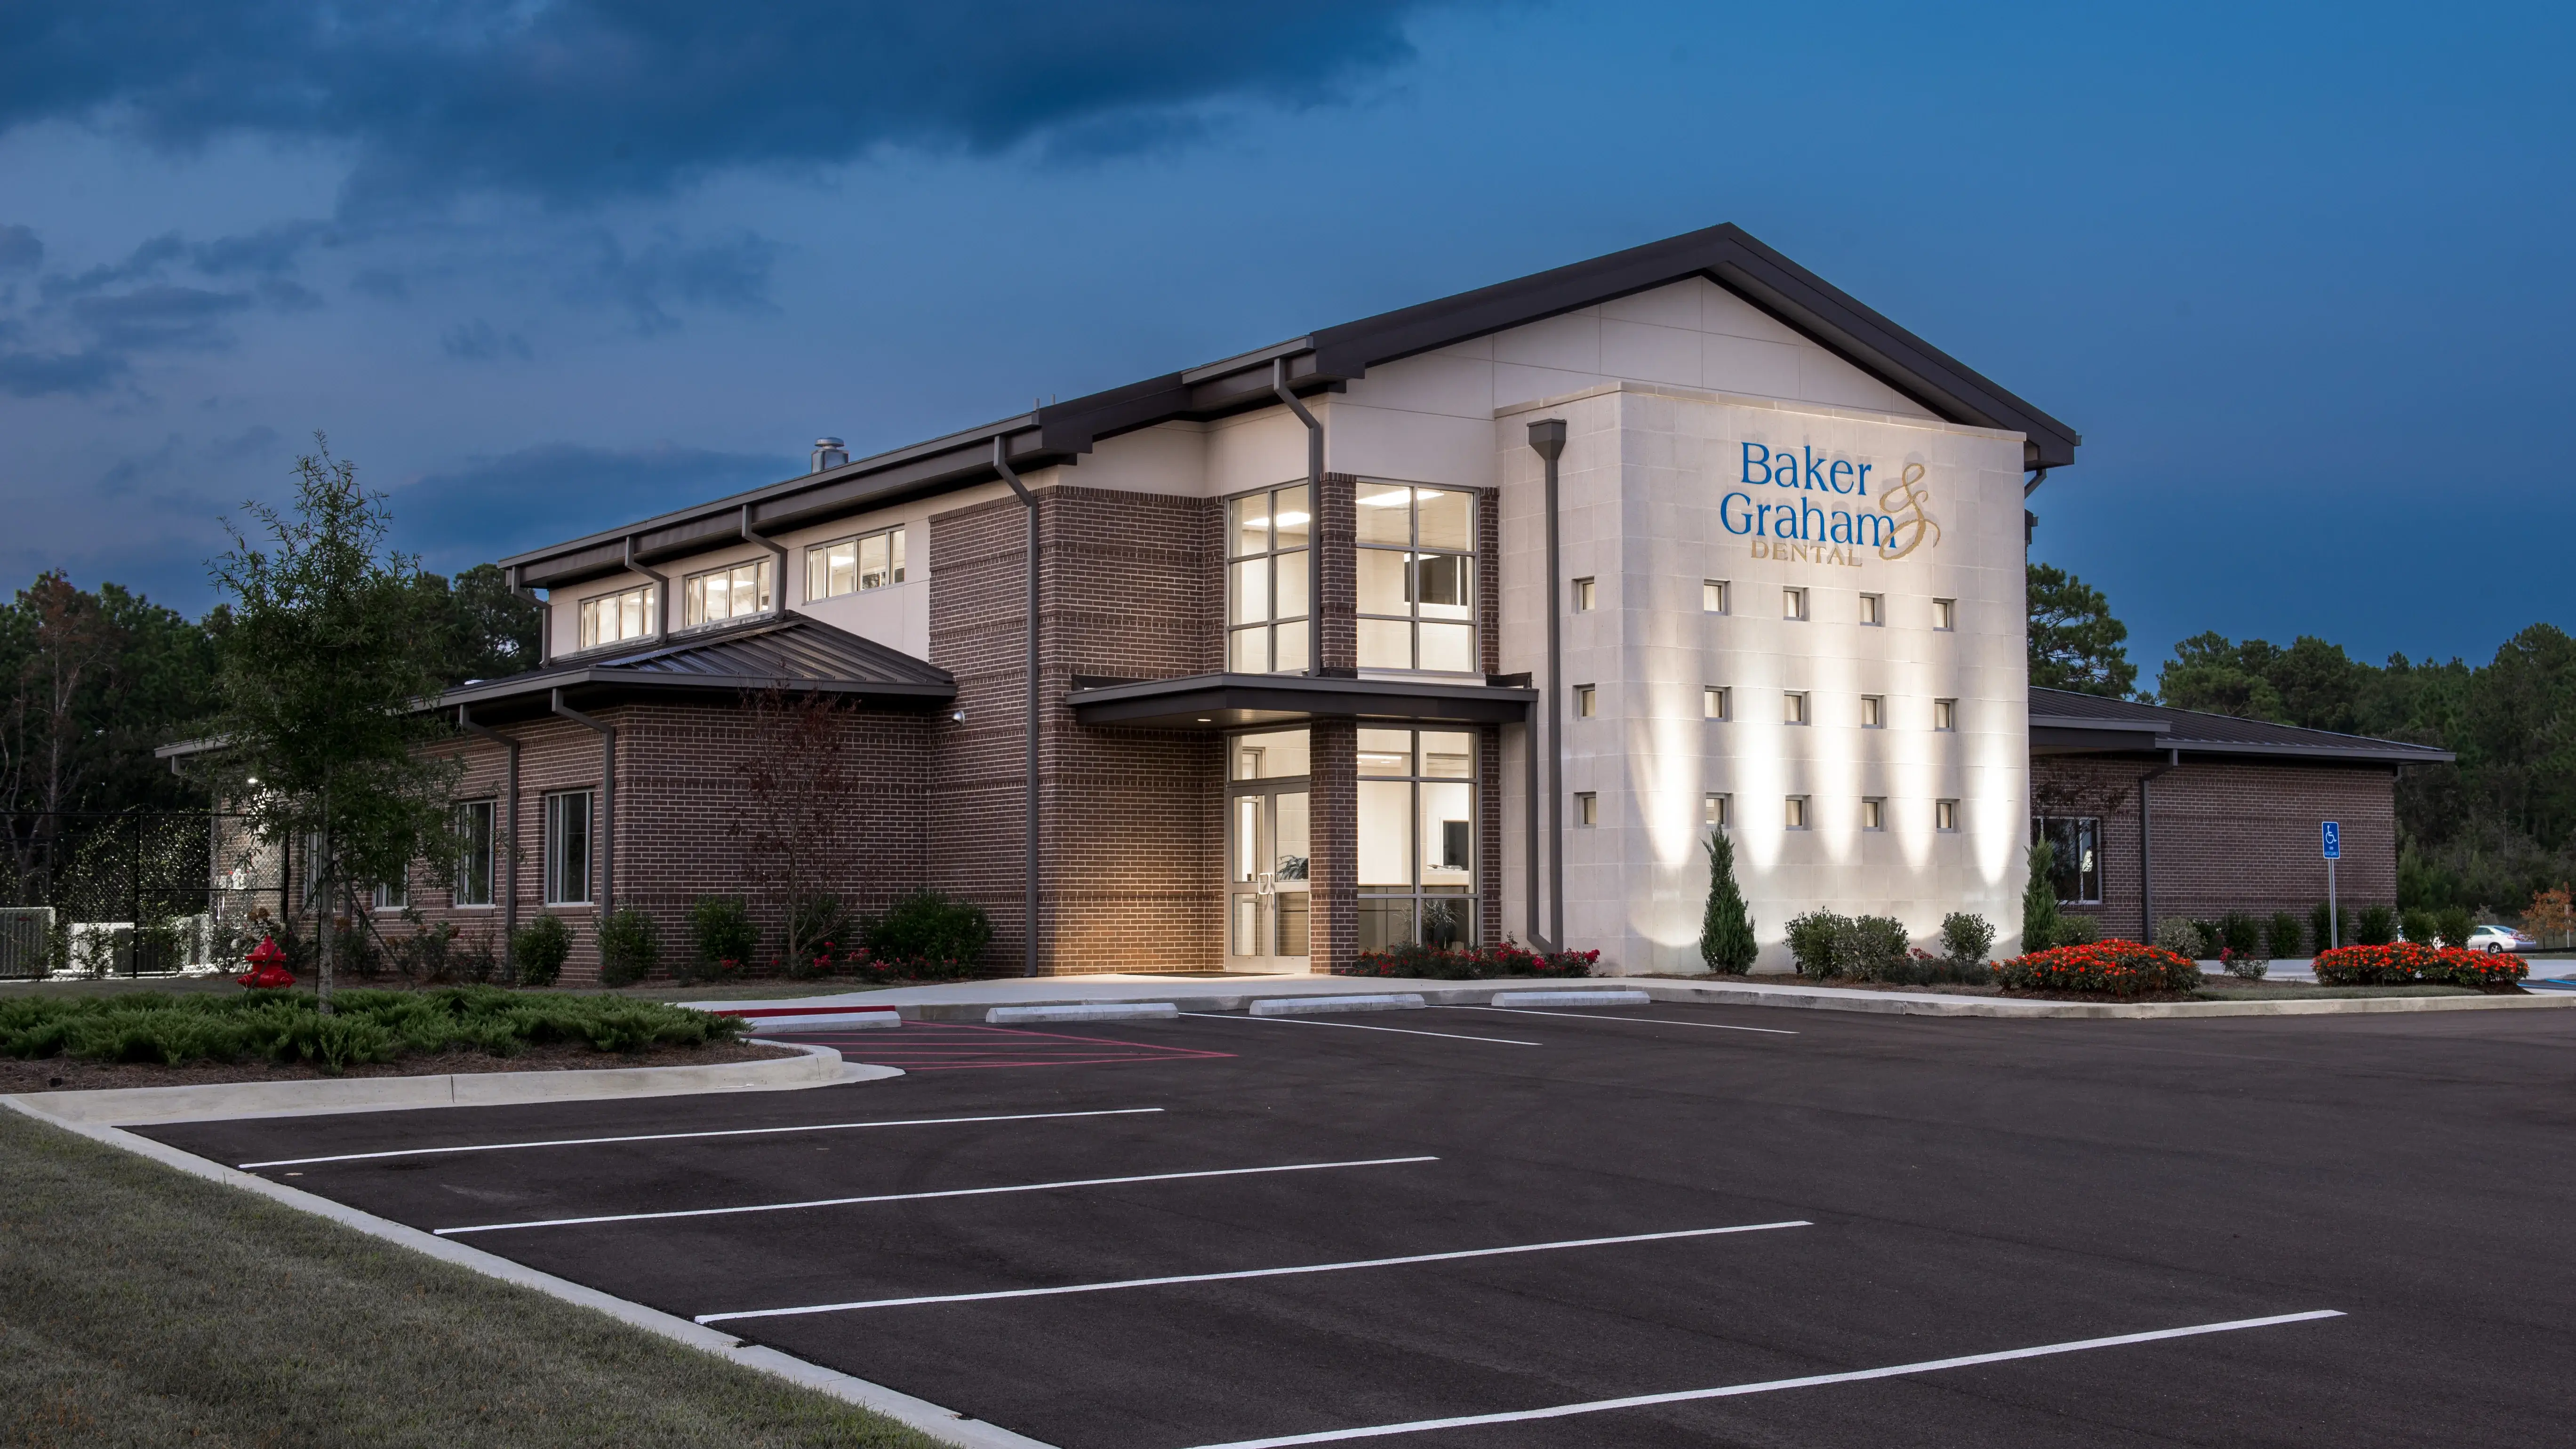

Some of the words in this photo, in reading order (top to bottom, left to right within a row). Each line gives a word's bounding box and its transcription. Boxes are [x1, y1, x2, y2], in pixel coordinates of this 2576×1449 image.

[1720, 492, 1896, 548] Graham
[1742, 442, 1872, 496] Baker
[1879, 463, 1941, 560] &
[1751, 540, 1862, 567] DENTAL
